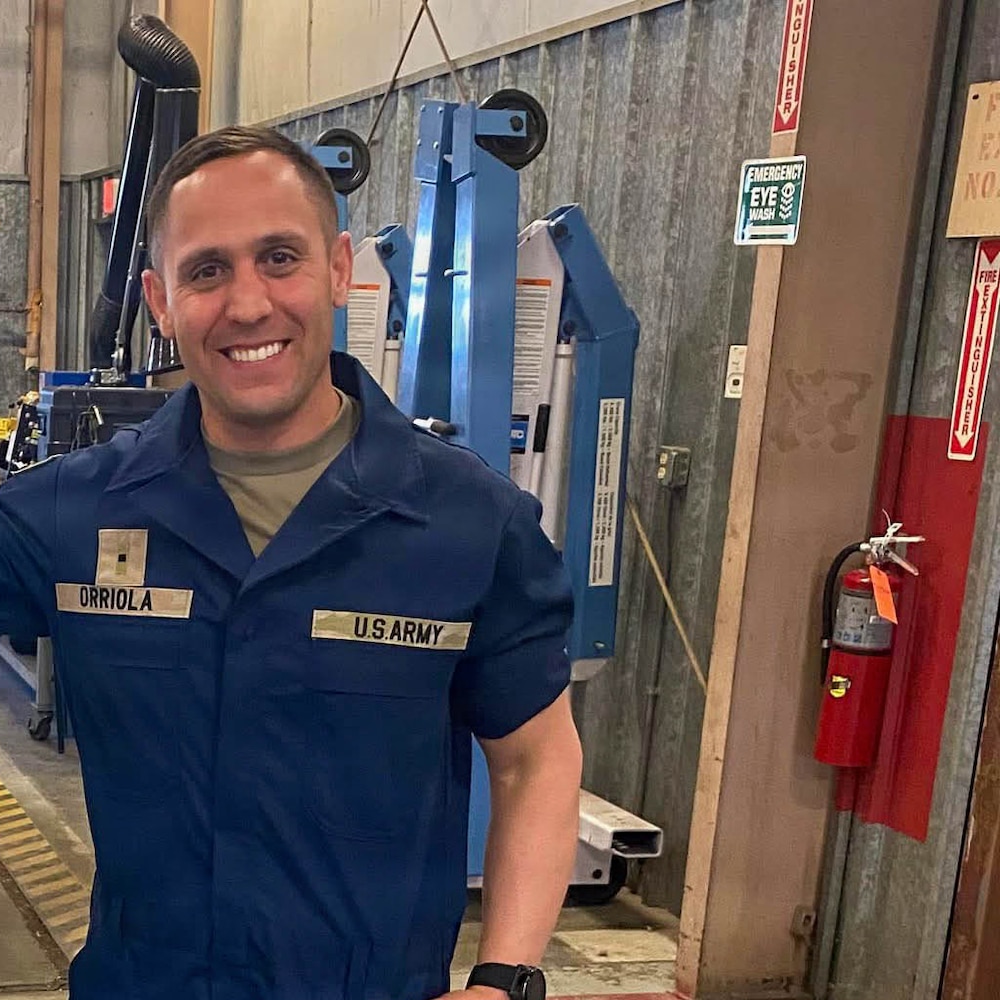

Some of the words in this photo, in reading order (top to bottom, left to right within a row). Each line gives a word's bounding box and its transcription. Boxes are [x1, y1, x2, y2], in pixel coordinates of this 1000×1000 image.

[749, 164, 803, 182] EMERGENCY
[750, 186, 778, 207] EYE
[749, 208, 776, 221] WASH
[979, 270, 998, 284] FIRE
[961, 284, 990, 436] EXTINGUISHER
[79, 586, 153, 612] ORRIOLA
